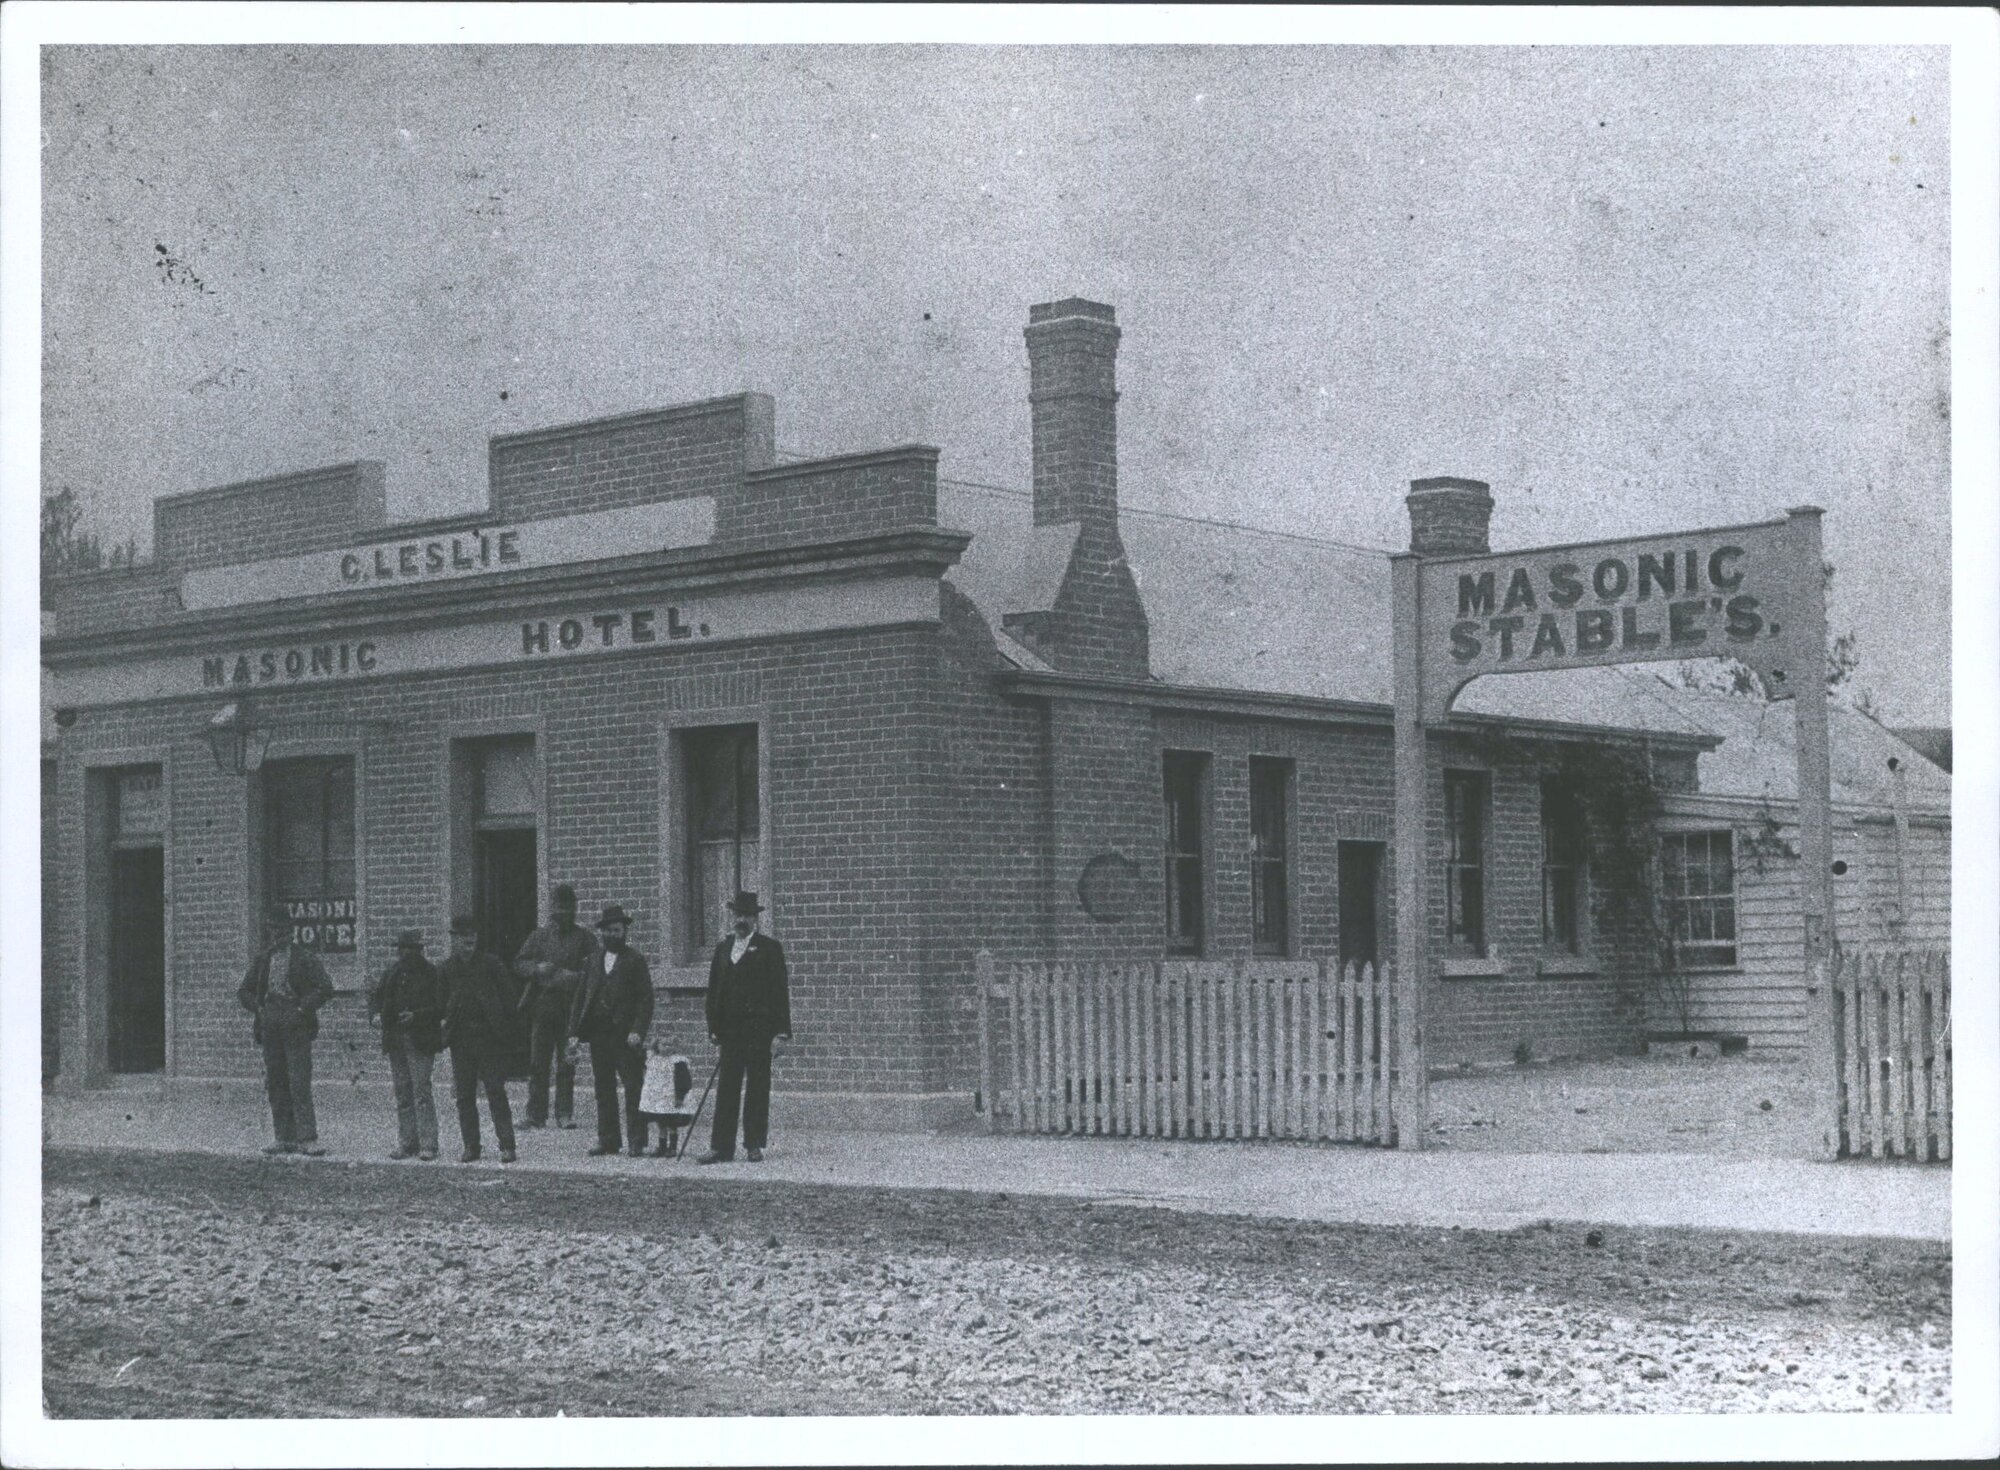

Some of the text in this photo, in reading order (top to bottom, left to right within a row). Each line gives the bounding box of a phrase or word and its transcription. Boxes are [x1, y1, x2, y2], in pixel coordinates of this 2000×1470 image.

[1457, 546, 1746, 617] MASONIC
[203, 641, 377, 687] MASONIC
[292, 923, 357, 945] OTE
